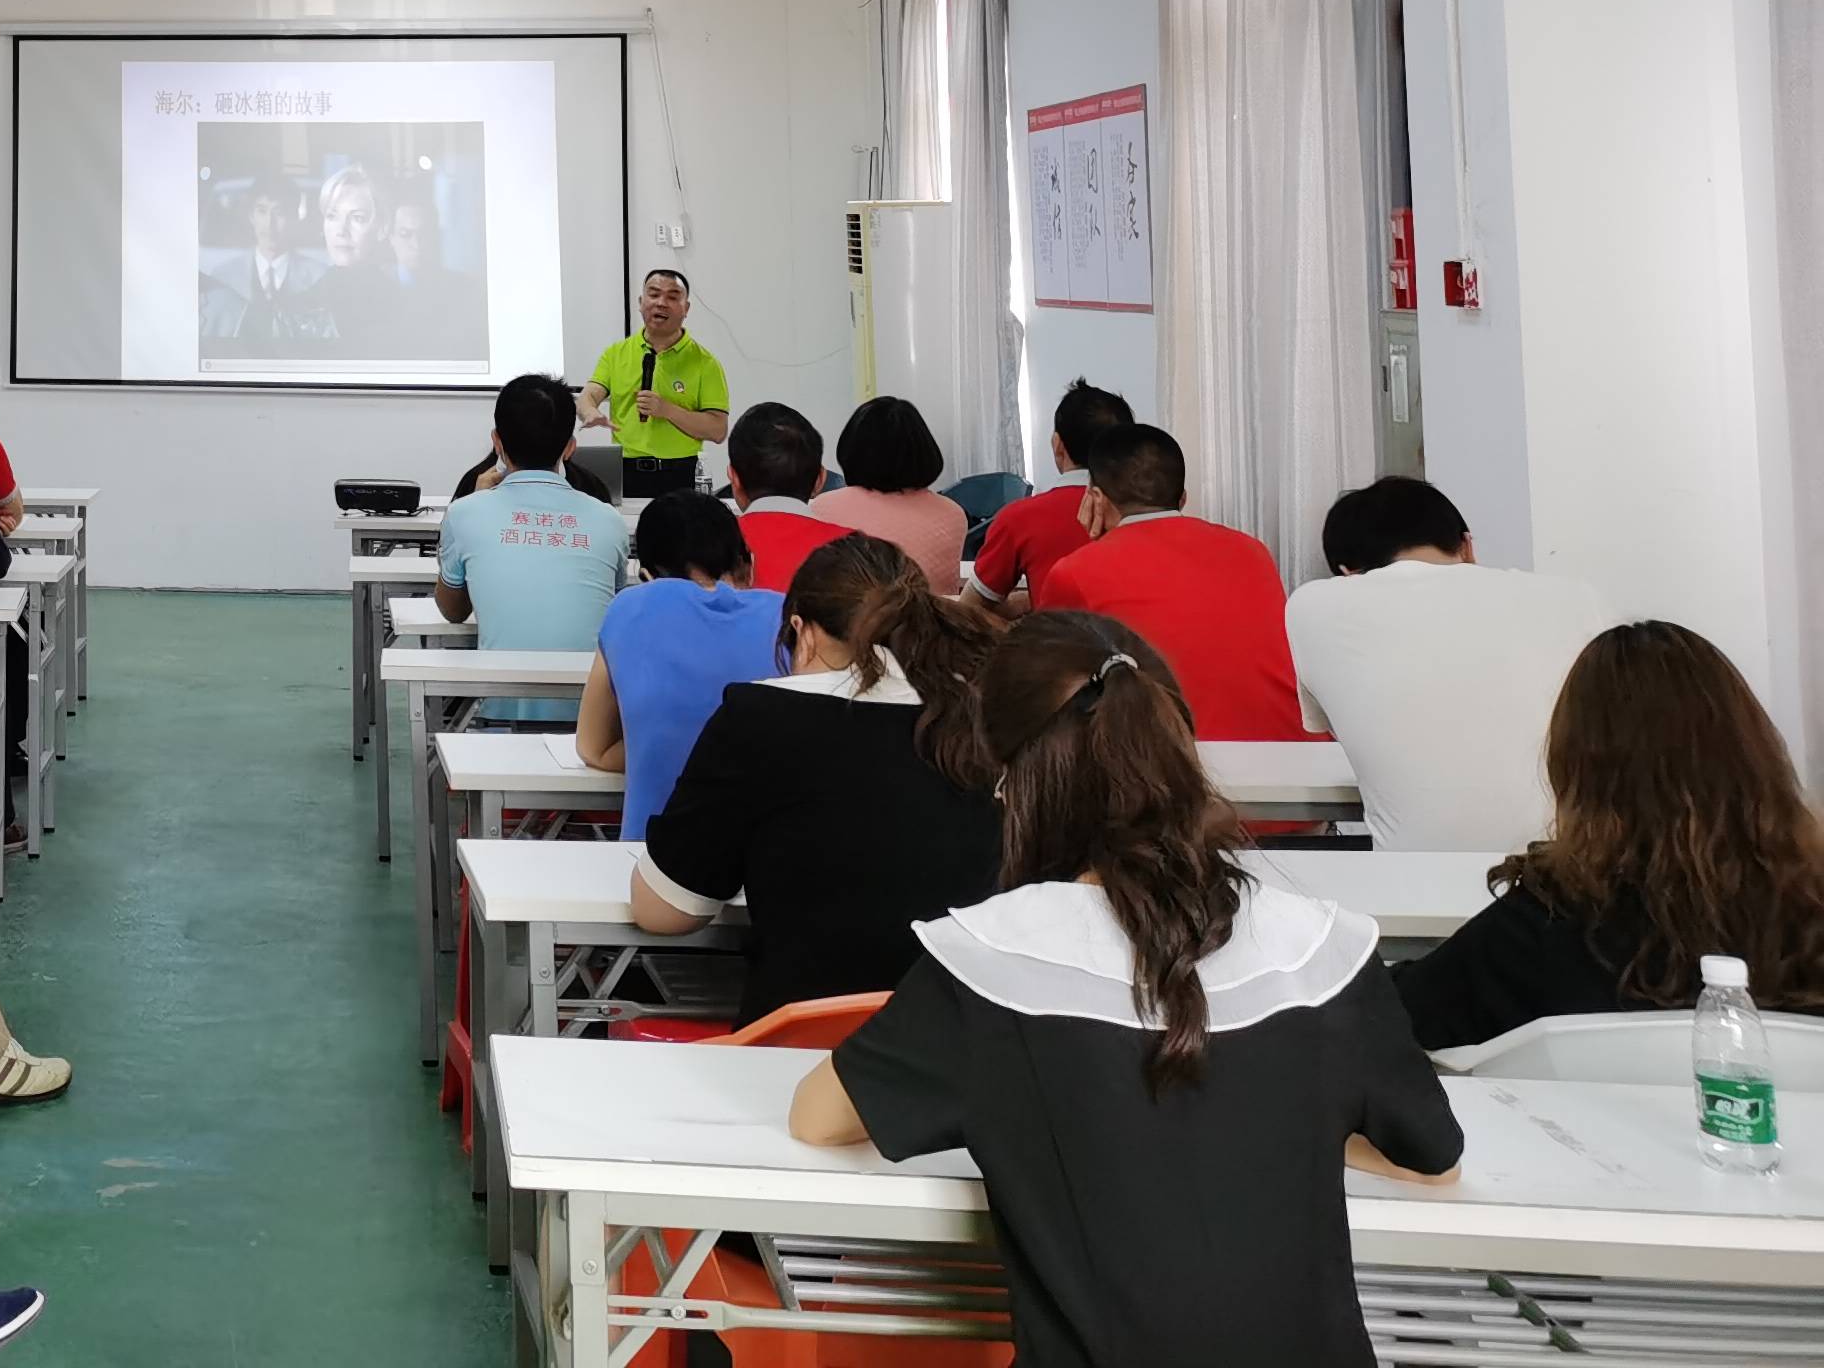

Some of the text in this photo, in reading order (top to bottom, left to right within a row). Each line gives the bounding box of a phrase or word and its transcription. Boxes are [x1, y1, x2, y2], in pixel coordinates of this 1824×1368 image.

[511, 511, 578, 529] 赛诺德
[499, 528, 592, 552] 酒店家具
